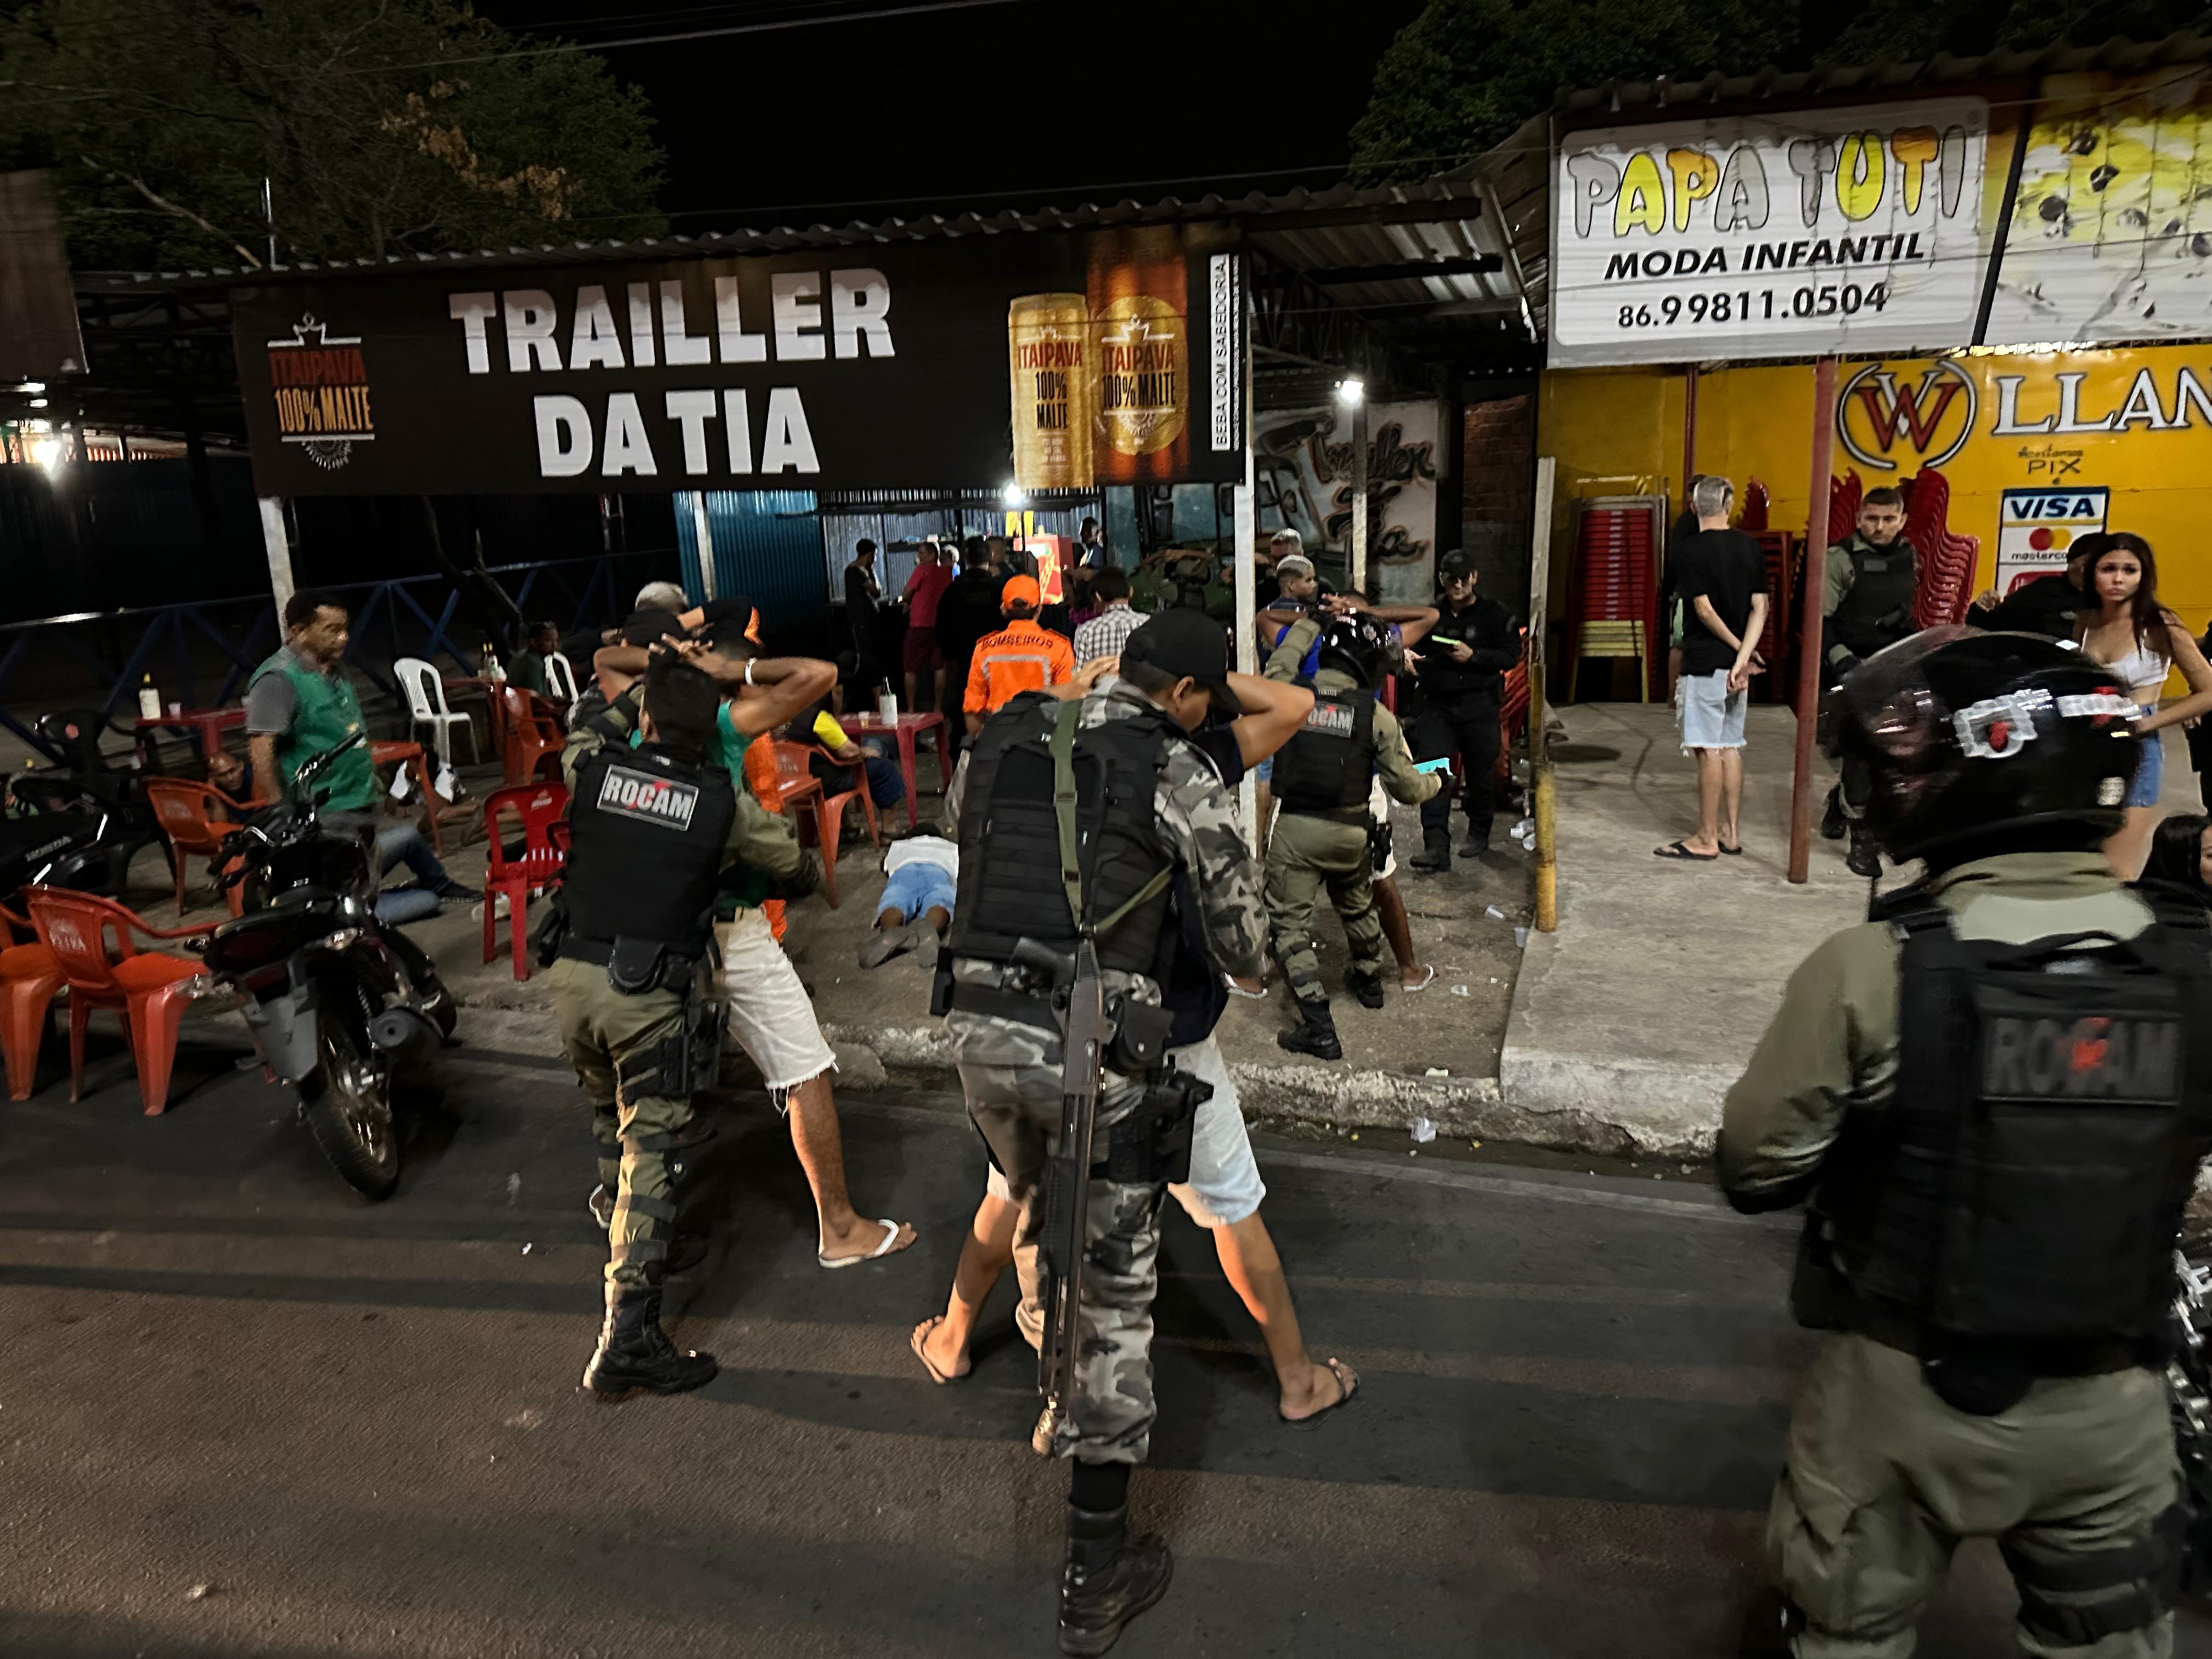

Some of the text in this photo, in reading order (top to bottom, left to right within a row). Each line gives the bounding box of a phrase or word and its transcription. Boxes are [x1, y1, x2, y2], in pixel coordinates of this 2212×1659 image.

[1566, 124, 1967, 238] PAPA TUTI
[1604, 232, 1925, 281] MODA INFANTIL
[448, 268, 895, 374] TRAILLER
[1618, 281, 1888, 329] 86.99811.0504
[1018, 341, 1083, 369] ITAIPAVA
[1102, 342, 1175, 373] ITAIPAVA
[1215, 258, 1228, 445] BEBA COM SABEDORIA
[1035, 370, 1067, 401] 100%
[1102, 371, 1176, 408] 100% MALTE
[274, 385, 374, 432] 100% MALTE
[1036, 403, 1069, 430] MALTE
[2028, 458, 2081, 475] PIX
[2011, 498, 2095, 519] VISA
[980, 634, 1054, 652] BOMBEIROS
[1307, 706, 1352, 730] OCAM
[603, 772, 693, 821] ROCAM
